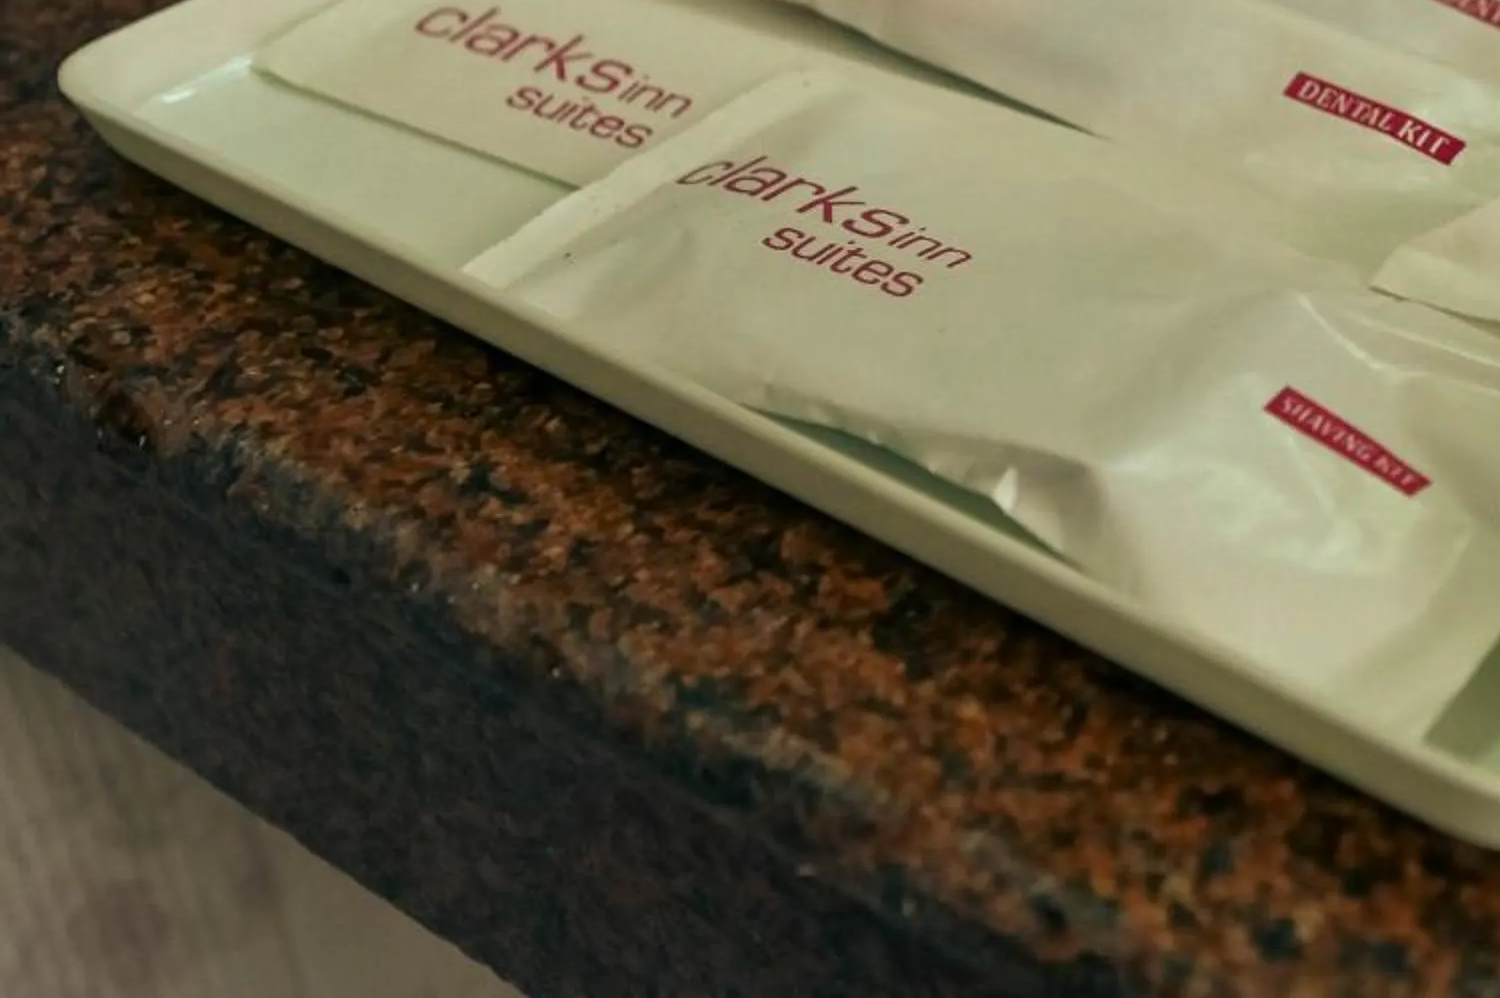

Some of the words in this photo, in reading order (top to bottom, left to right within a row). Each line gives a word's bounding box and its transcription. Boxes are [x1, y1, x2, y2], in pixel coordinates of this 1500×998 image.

[505, 85, 654, 149] suites
[1299, 79, 1394, 133] DENTAL
[1397, 120, 1451, 155] KIT
[762, 226, 924, 298] suites
[1282, 397, 1372, 462] SHAVING
[1373, 454, 1417, 486] KIT
